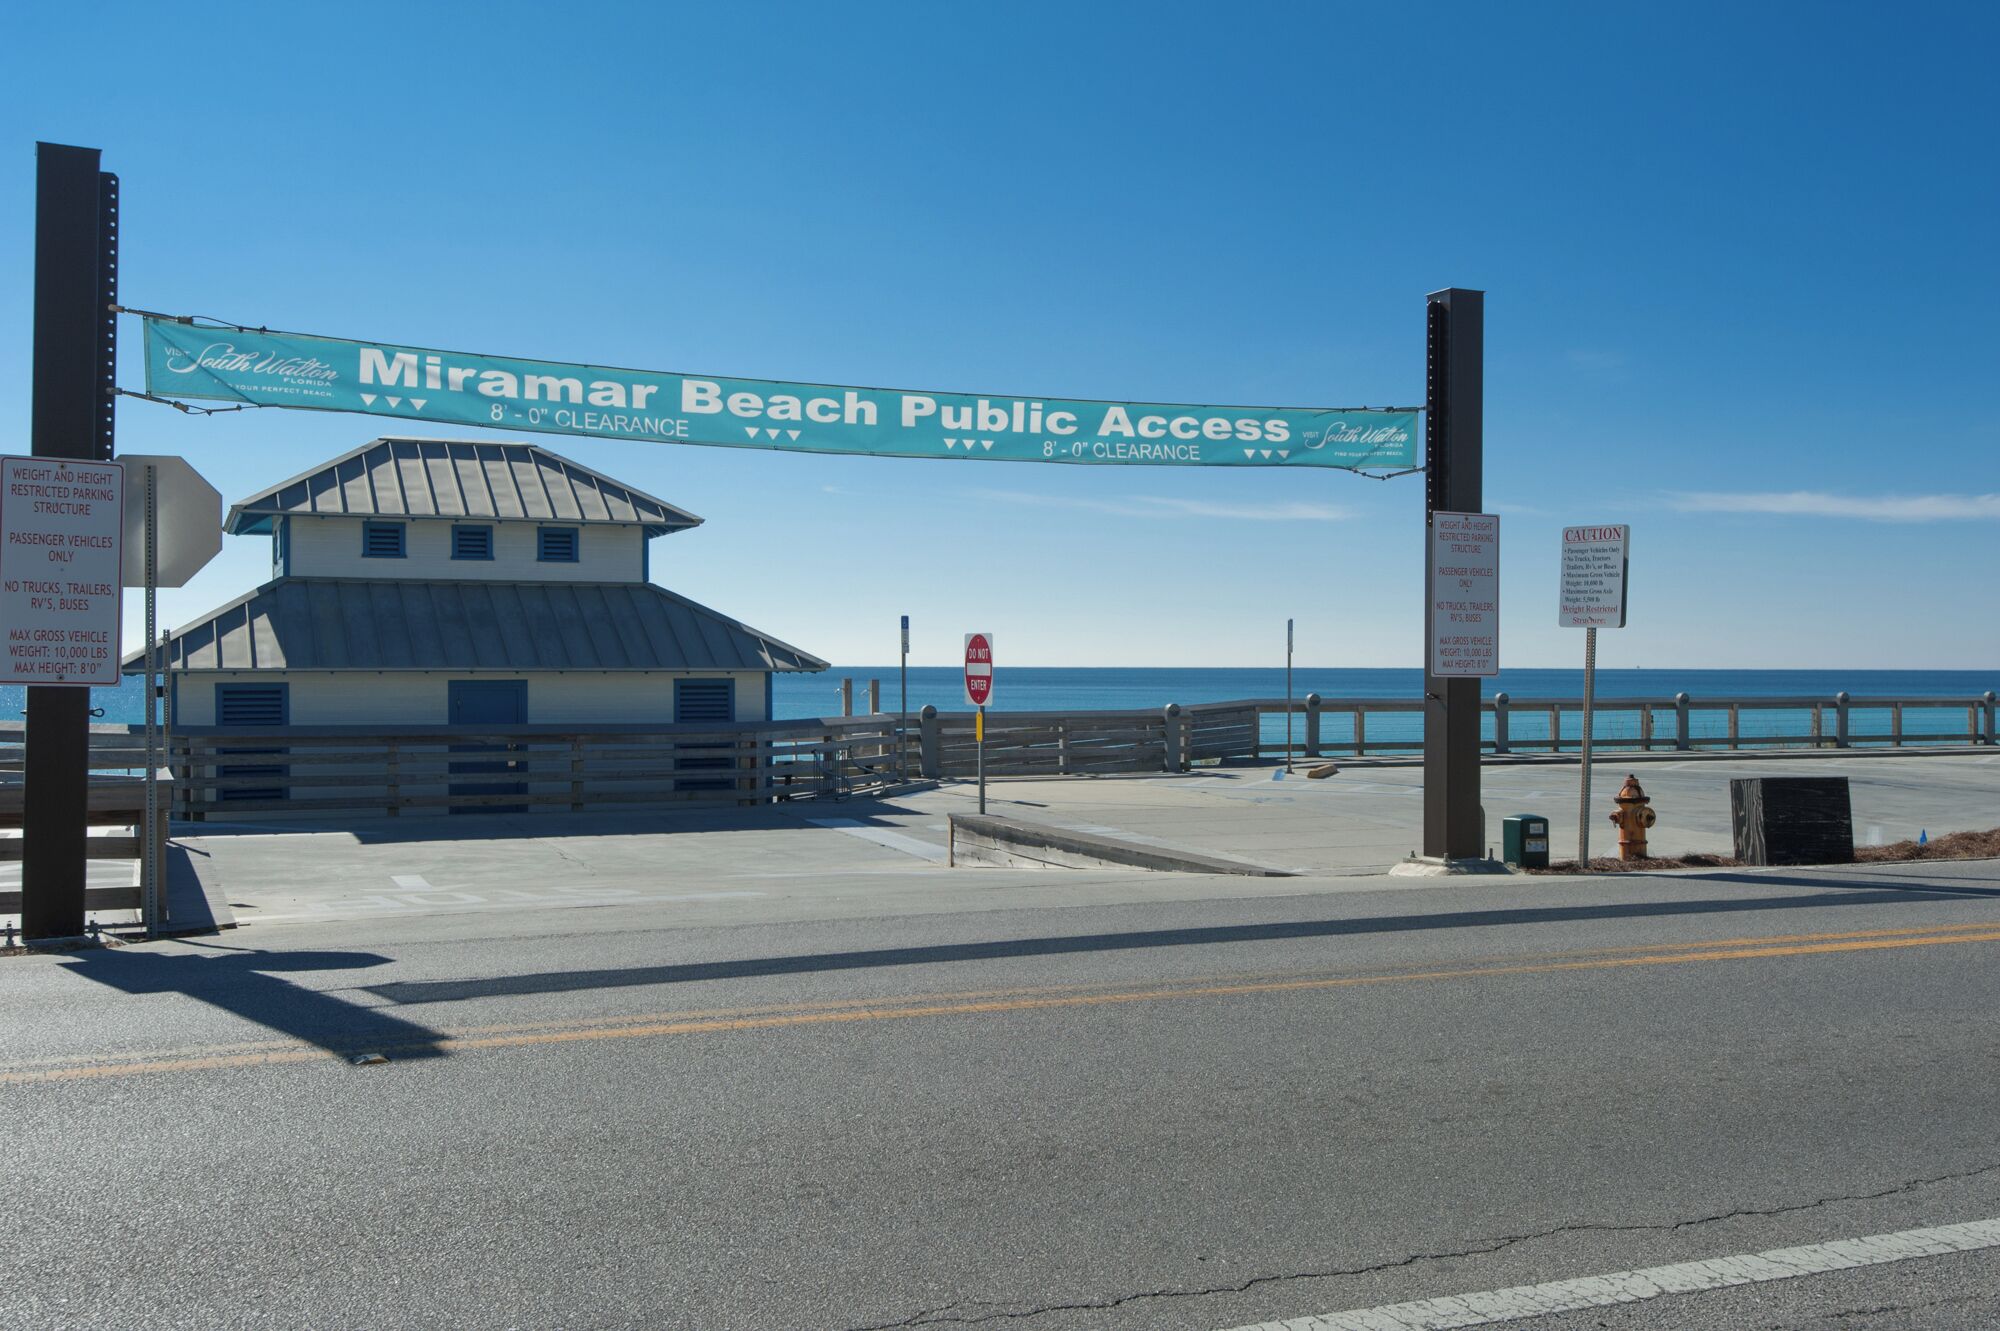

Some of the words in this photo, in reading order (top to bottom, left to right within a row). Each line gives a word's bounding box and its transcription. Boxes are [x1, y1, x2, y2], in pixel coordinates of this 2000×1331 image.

[167, 342, 259, 373] South
[284, 377, 332, 387] FLORIDA
[236, 384, 258, 392] YOUR
[262, 386, 300, 395] PERFECT
[304, 390, 334, 398] BEACH.
[359, 347, 659, 409] Miramar
[682, 378, 877, 425] Beach
[902, 395, 1078, 434] Public
[1097, 406, 1291, 442] Access
[554, 409, 688, 438] CLEARANCE
[1304, 422, 1361, 449] South
[1093, 442, 1200, 460] CLEARANCE
[13, 468, 51, 481] WEIGHT
[54, 471, 74, 482] AND
[78, 472, 112, 484] HEIGHT
[11, 484, 70, 498] RESTRICTED
[73, 488, 114, 501] PARKING
[34, 502, 91, 516] STRUCTURE
[1440, 520, 1460, 530] WEIGHT
[1462, 521, 1472, 530] AND
[1474, 522, 1492, 531] HEIGHT
[10, 532, 65, 546] PASSENGER
[68, 536, 112, 548] VEHICLES
[1440, 532, 1470, 542] RESTRICTED
[1472, 533, 1493, 543] PARKING
[1565, 527, 1621, 541] CAUTION
[1451, 544, 1481, 554] STRUCTURE
[48, 550, 74, 562] ONLY
[1439, 567, 1468, 576] PASSENGER
[1469, 568, 1493, 576] VEHICLES
[4, 581, 19, 592] NO
[22, 582, 63, 595] TRUCKS,
[68, 583, 114, 597] TRAILERS,
[31, 598, 56, 611] RV'S,
[60, 599, 89, 611] BUSES
[1436, 602, 1445, 610] NO
[1446, 602, 1468, 612] TRUCKS,
[1563, 605, 1585, 613] Weight
[1586, 605, 1617, 613] Restricted
[1466, 614, 1482, 623] BUSES
[10, 630, 30, 641] MAX
[34, 630, 65, 642] GROSS
[69, 630, 108, 642] VEHICLE
[1440, 636, 1452, 645] MAX
[1452, 636, 1469, 645] GROSS
[1470, 636, 1492, 645] VEHICLE
[10, 645, 50, 657] WEIGHT:
[55, 646, 88, 660] 10,000
[91, 646, 108, 659] LBS
[969, 648, 976, 659] DO
[978, 648, 989, 659] NOT
[1440, 648, 1461, 656] WEIGHT:
[1482, 648, 1492, 656] LBS
[14, 662, 35, 673] MAX
[38, 662, 77, 674] HEIGHT:
[80, 662, 101, 674] 8'0"
[1442, 660, 1453, 668] MAX
[971, 680, 987, 690] ENTER
